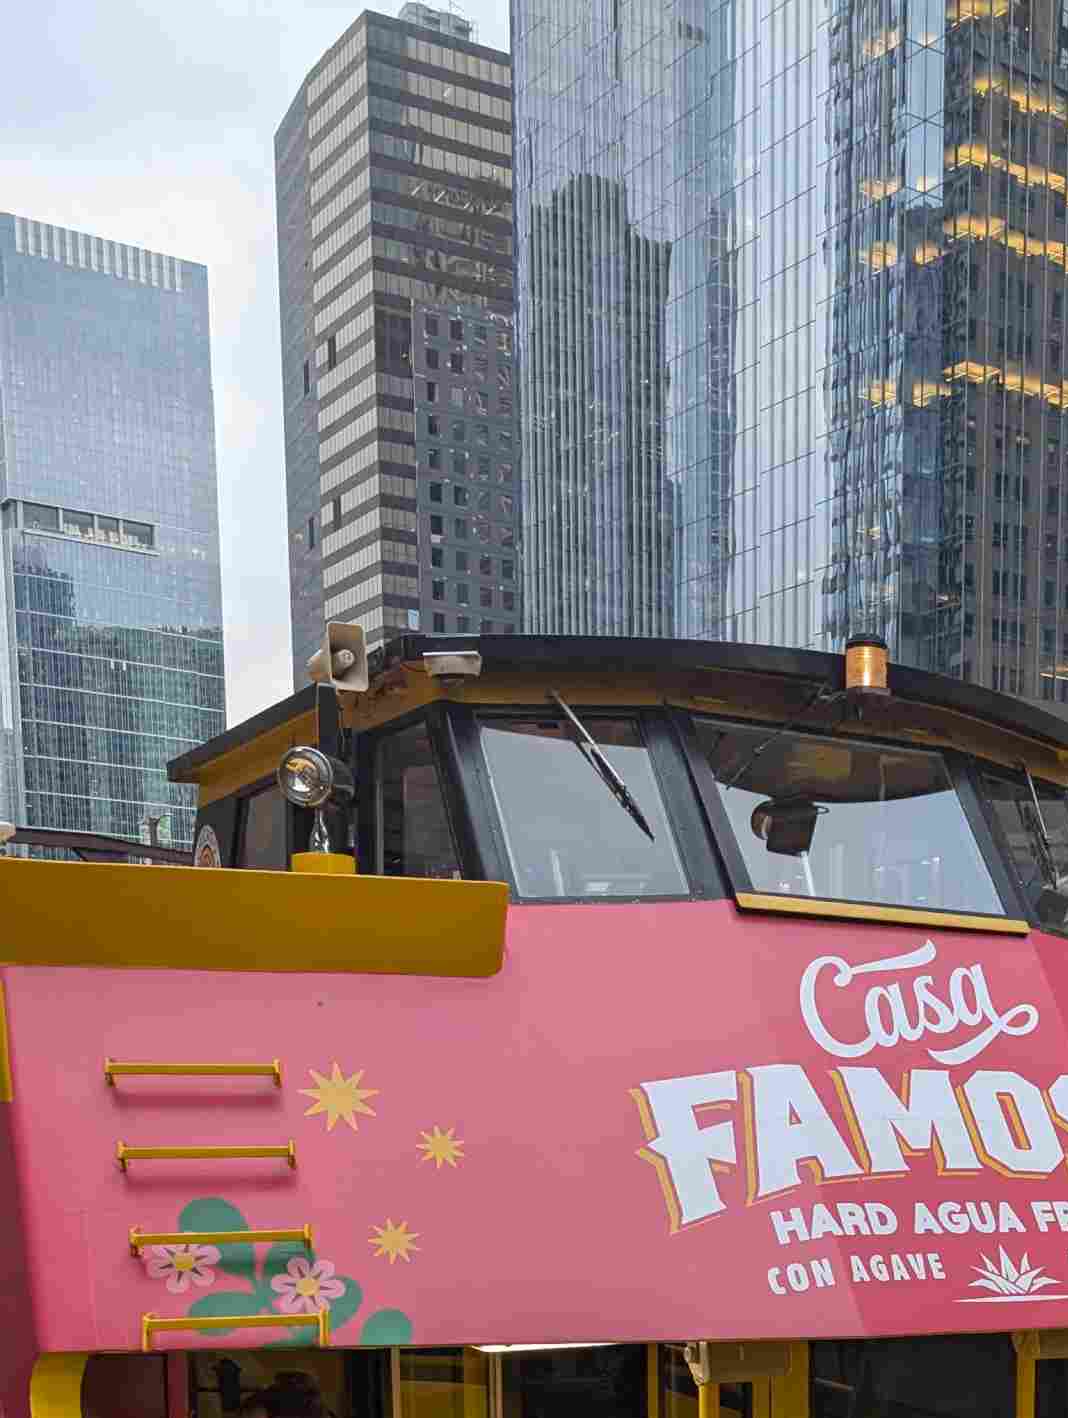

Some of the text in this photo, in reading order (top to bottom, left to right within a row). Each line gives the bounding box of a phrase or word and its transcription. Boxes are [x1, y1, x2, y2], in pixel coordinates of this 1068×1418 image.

[800, 939, 1039, 1065] Casa
[769, 1202, 898, 1244] HARD
[914, 1201, 1026, 1234] AGUA
[767, 1258, 836, 1294] CON
[850, 1252, 946, 1282] AGAVE
